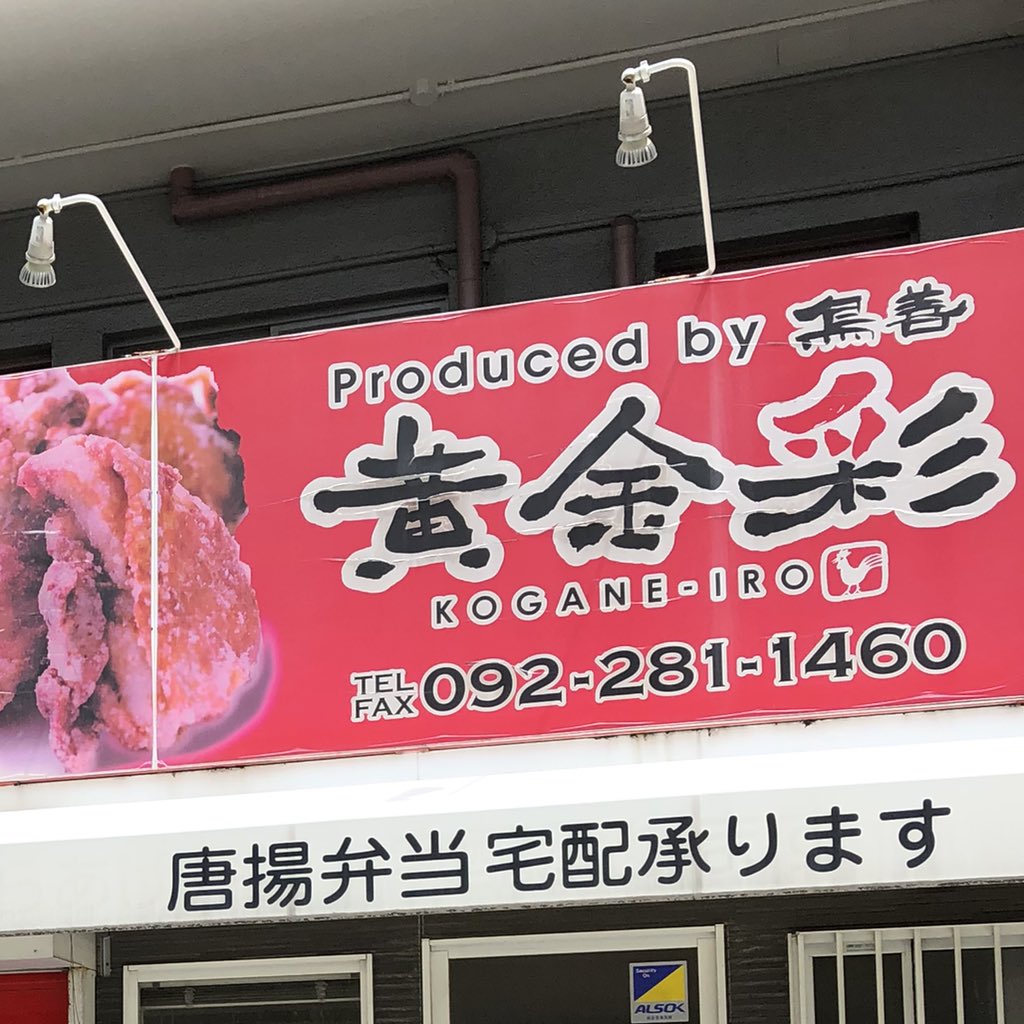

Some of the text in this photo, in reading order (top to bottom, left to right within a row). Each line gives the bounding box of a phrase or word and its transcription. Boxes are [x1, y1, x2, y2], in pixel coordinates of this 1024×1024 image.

[329, 323, 647, 408] Produced
[678, 313, 764, 366] by
[304, 360, 1012, 588] 黄金彩
[431, 561, 812, 629] KOGANE-IRO
[350, 669, 415, 697] TEL
[351, 620, 967, 722] FAX 092-281-1460
[170, 799, 951, 914] 唐揚弁当宅配承ります
[634, 1003, 685, 1014] ALSOK
